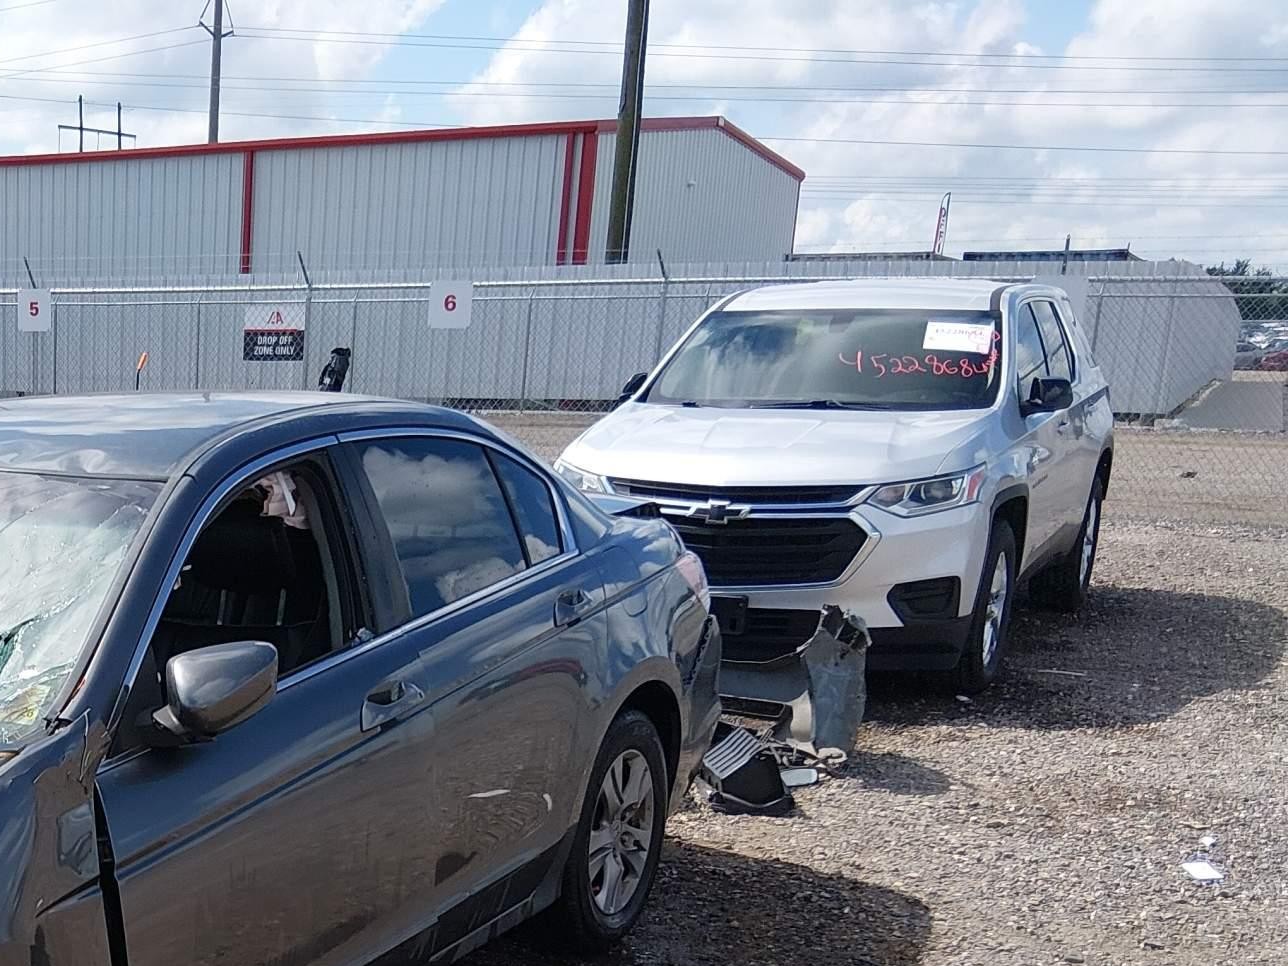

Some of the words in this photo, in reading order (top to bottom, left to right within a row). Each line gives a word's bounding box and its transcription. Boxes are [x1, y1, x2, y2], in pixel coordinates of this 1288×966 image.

[29, 301, 39, 317] 5
[444, 294, 457, 312] 6
[257, 336, 278, 345] DROP
[279, 336, 293, 345] OFF
[253, 346, 273, 355] ZONE
[275, 346, 295, 355] ONLY
